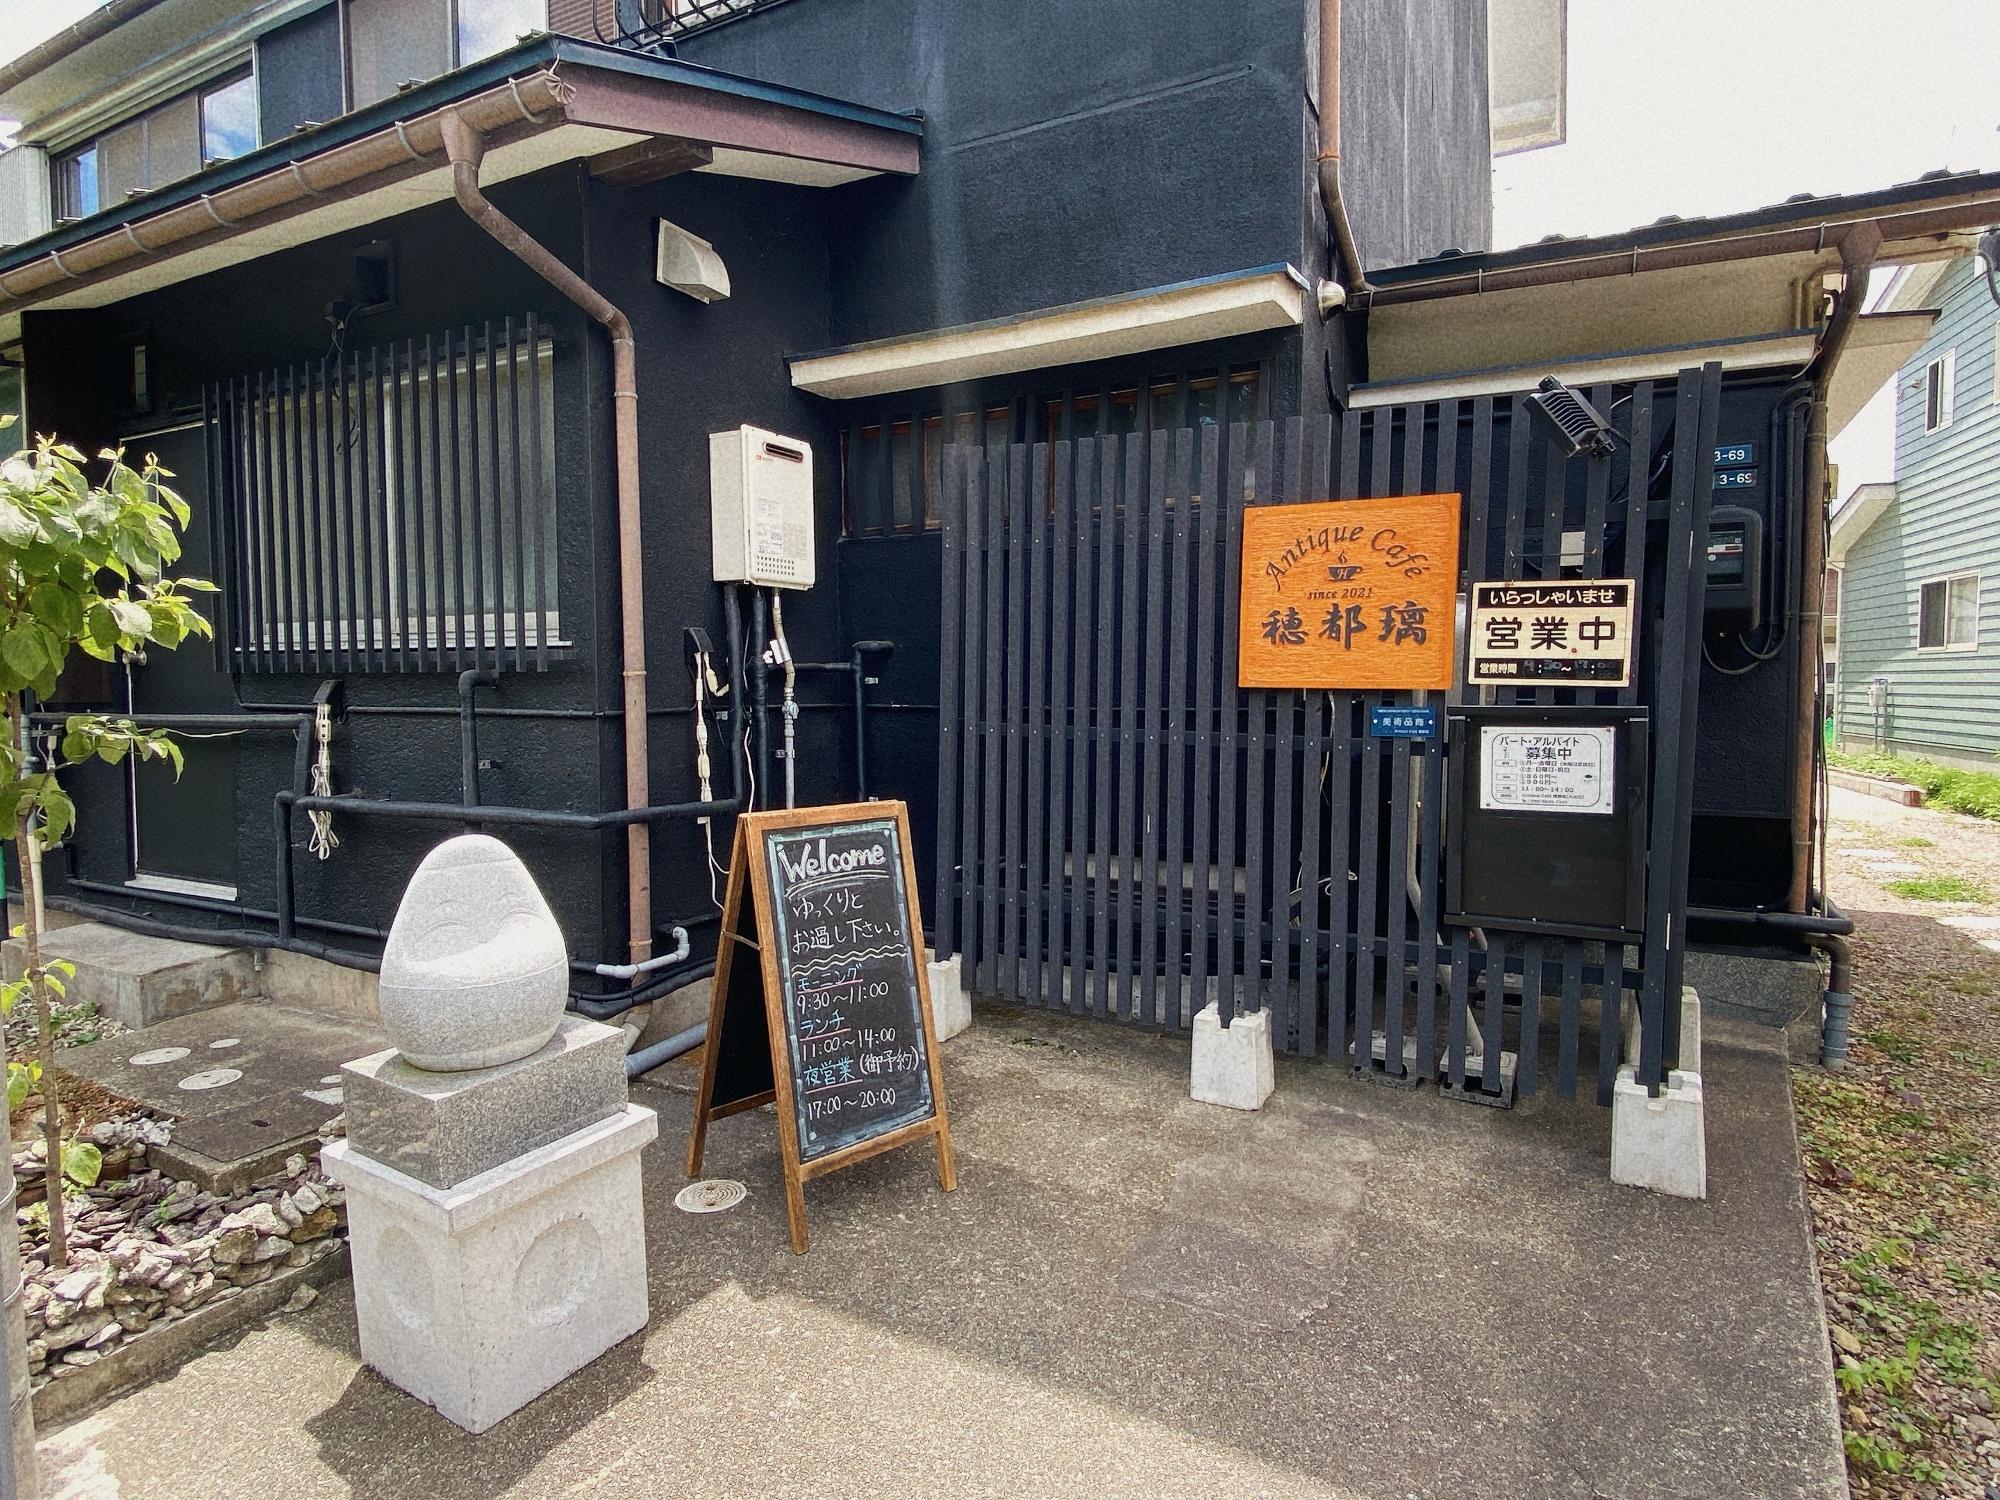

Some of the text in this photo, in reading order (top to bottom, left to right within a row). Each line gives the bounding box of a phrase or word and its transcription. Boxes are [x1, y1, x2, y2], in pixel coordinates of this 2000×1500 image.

[1714, 449, 1745, 462] 3-69
[1266, 525, 1430, 592] Antique Café
[1306, 587, 1373, 600] since 2021
[1490, 589, 1616, 605] いらっしゃいませ
[1261, 600, 1429, 651] 穂都璃
[1485, 616, 1616, 651] 営業中
[1479, 663, 1518, 675] 営業時間
[1382, 717, 1425, 727] 美術品商
[1526, 747, 1572, 760] 募集中
[778, 838, 886, 883] Welcome
[792, 888, 863, 920] ゆっくりと
[792, 918, 900, 953] お過し下さい。
[798, 964, 863, 991] モーニング
[800, 1009, 845, 1038] ランチ
[804, 1056, 855, 1086] 夜営業
